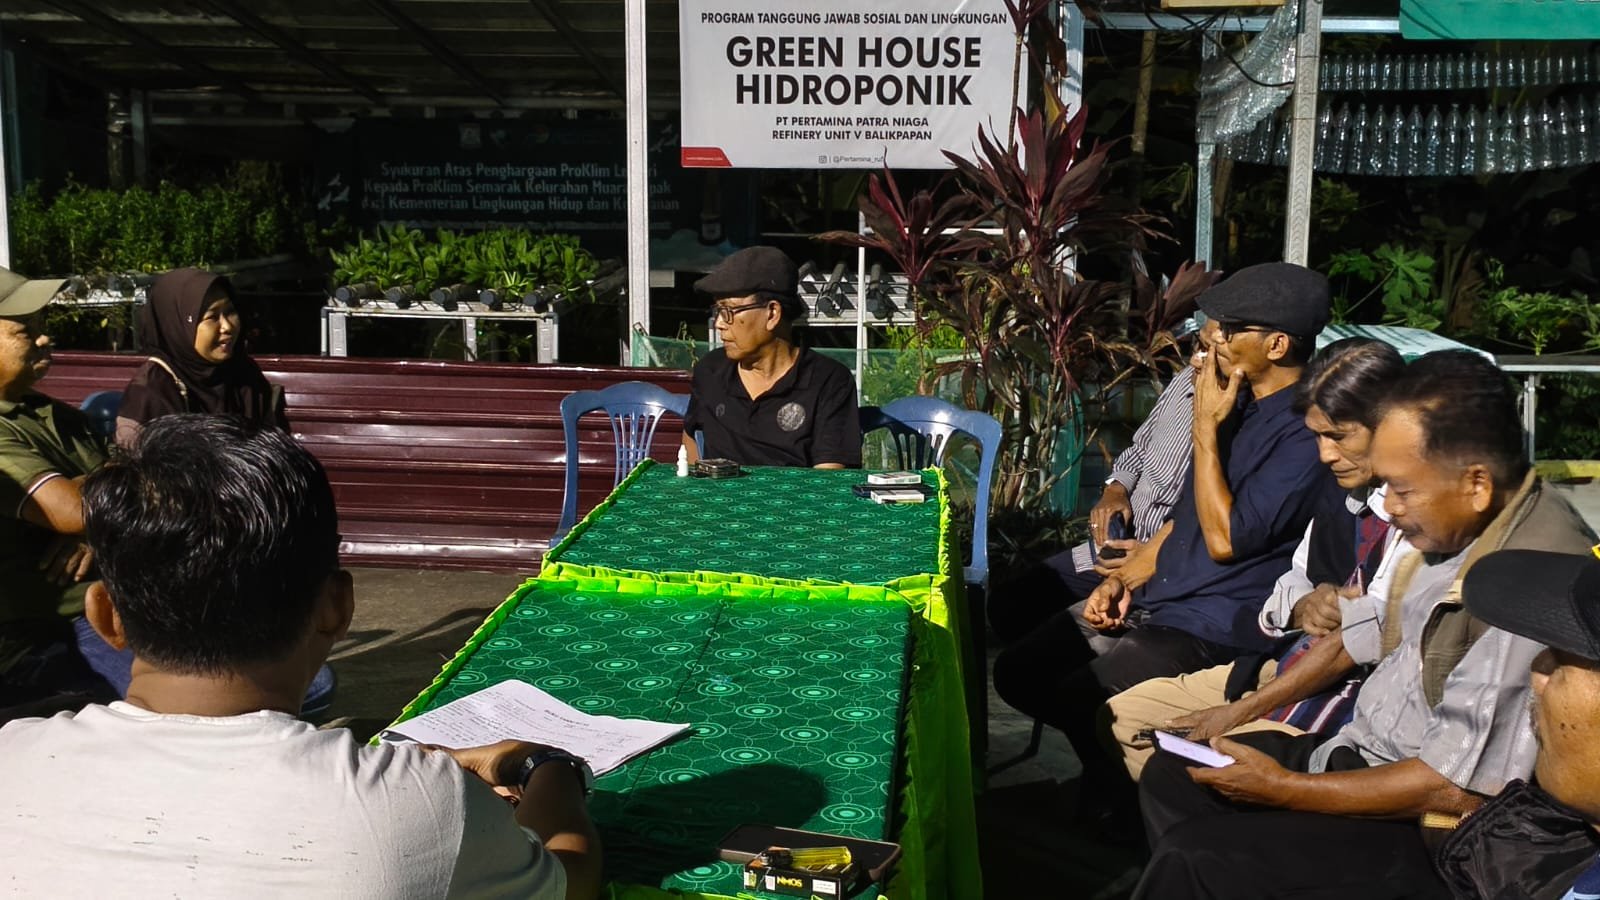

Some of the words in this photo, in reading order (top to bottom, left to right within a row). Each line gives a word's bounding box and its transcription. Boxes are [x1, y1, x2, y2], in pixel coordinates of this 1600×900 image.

[701, 13, 755, 24] PROGRAM
[757, 13, 821, 24] TANGGUNG
[823, 13, 861, 24] JAWAB
[863, 13, 901, 24] SOSIAL
[904, 13, 928, 24] DAN
[931, 13, 1008, 25] LINGKUNGAN
[726, 36, 844, 67] GREEN
[858, 37, 982, 68] HOUSE
[736, 74, 973, 106] HIDROPONIK
[776, 117, 789, 126] PT
[791, 117, 853, 127] PERTAMINA
[855, 117, 890, 127] PATRA
[892, 117, 929, 127] NIAGA
[772, 130, 822, 140] REFINERY
[824, 130, 851, 140] UNIT
[853, 130, 862, 140] V
[865, 130, 932, 140] BALIKPAPAN
[381, 161, 441, 179] Syukuran
[444, 161, 473, 177] Atas
[476, 161, 557, 180] Penghargaan
[560, 161, 611, 177] ProKlim
[363, 178, 408, 198] Kepada
[412, 178, 462, 194] ProKlim
[465, 178, 521, 194] Semarak
[525, 178, 588, 195] Kelurahan
[388, 194, 469, 209] Kementerian
[471, 194, 544, 213] Lingkungan
[548, 195, 584, 213] Hidup
[586, 196, 609, 209] dan
